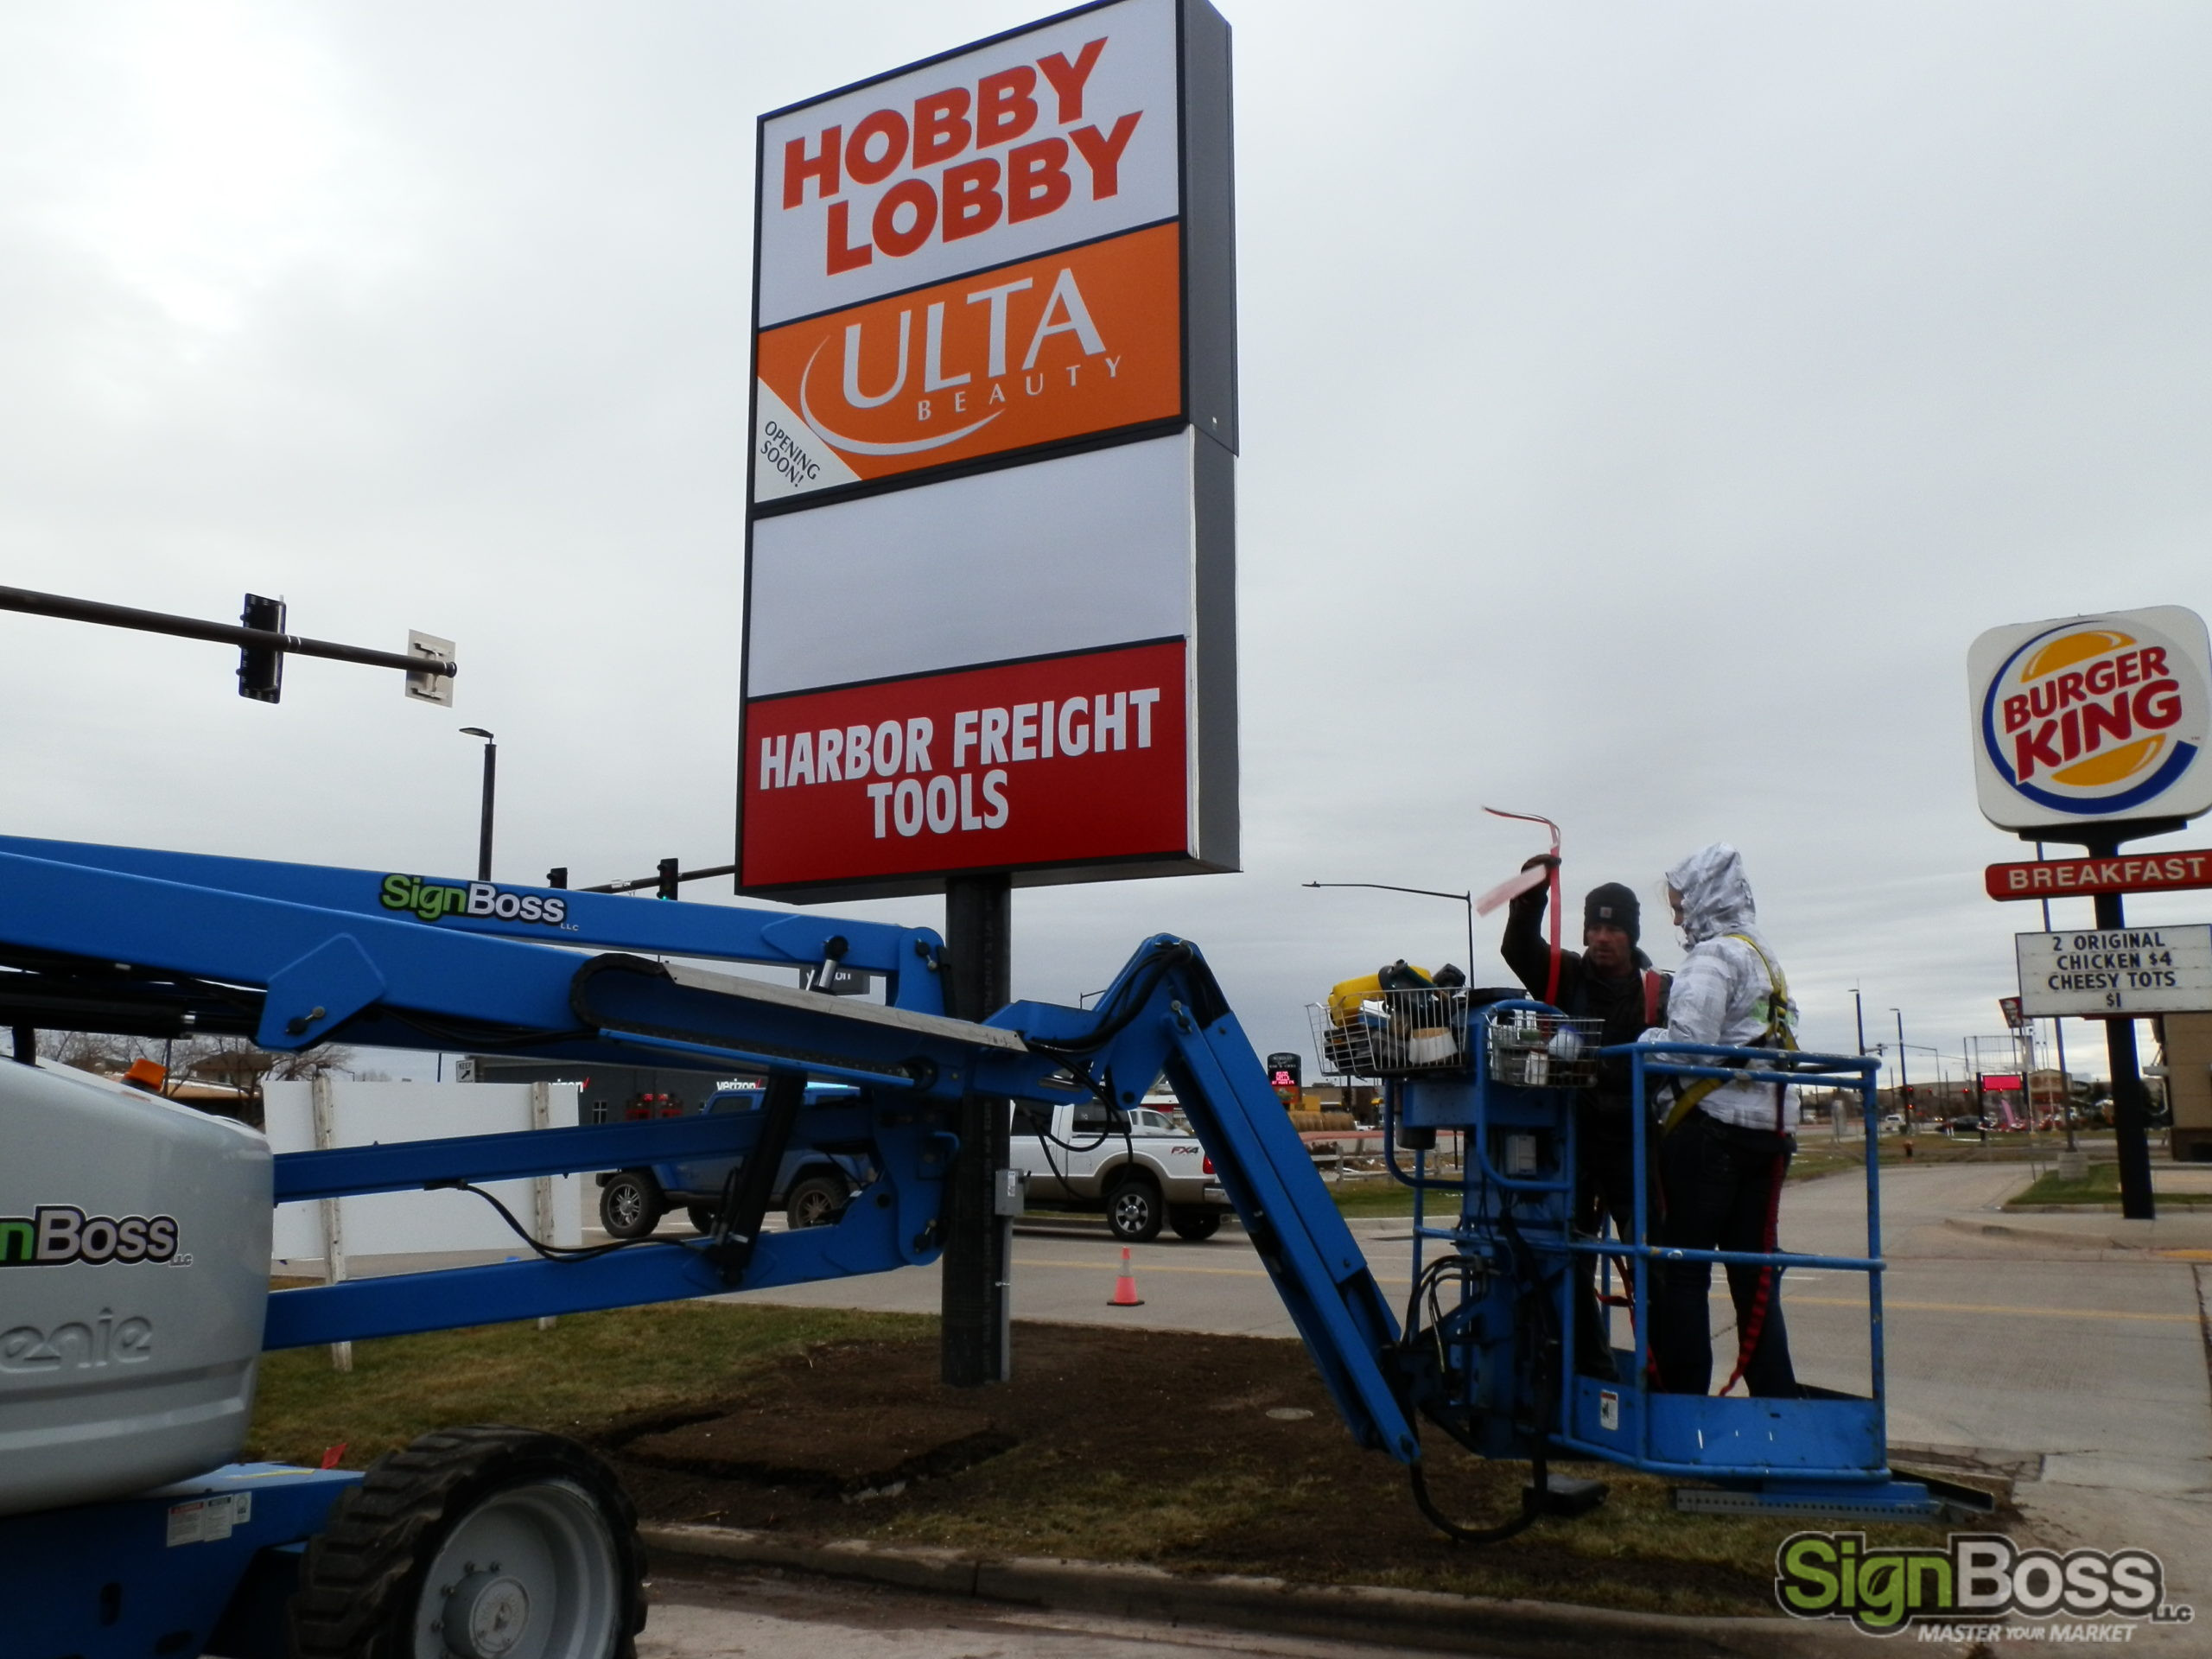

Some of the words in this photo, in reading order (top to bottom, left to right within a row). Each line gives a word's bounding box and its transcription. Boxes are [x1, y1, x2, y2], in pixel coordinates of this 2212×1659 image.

[784, 36, 1109, 210] HOBBY
[827, 111, 1143, 276] LOBBY
[843, 268, 1106, 408] ULTA
[918, 355, 1122, 422] BEAUTY
[760, 440, 804, 487] SOON!
[765, 421, 820, 480] OPENING
[2003, 646, 2170, 734] BURGER
[760, 716, 933, 791] HARBOR
[953, 687, 1160, 767] FREIGHT
[2015, 678, 2183, 782] KING
[868, 770, 1009, 838] TOOLS
[382, 874, 564, 923] SignBoss
[560, 922, 579, 931] LLC
[2008, 857, 2206, 890] BREAKFAST
[2053, 936, 2063, 951] 2
[2074, 932, 2165, 950] ORIGINAL
[2056, 953, 2141, 970] CHICKEN
[2149, 951, 2172, 967] $4
[2048, 972, 2120, 990] CHEESY
[2127, 971, 2176, 988] TOTS
[2106, 992, 2121, 1007] $1
[1171, 1146, 1199, 1154] FX4
[172, 1255, 193, 1266] LLC
